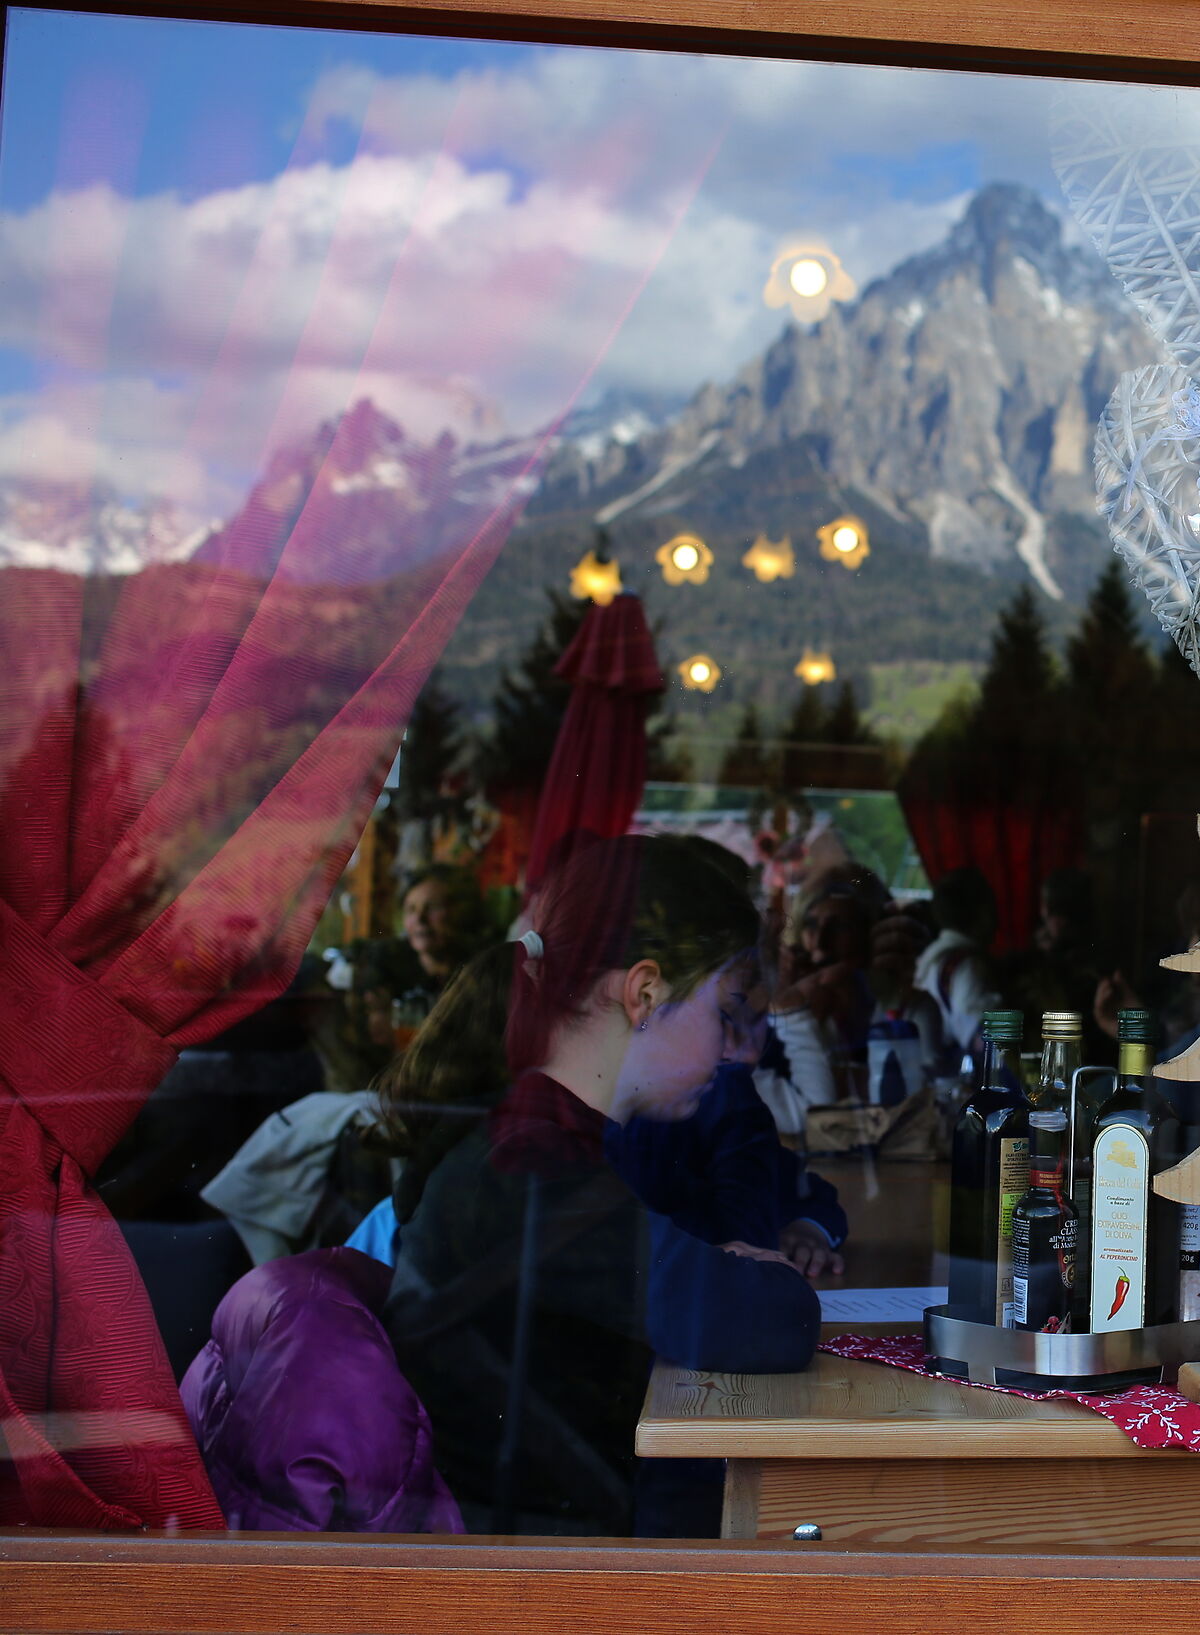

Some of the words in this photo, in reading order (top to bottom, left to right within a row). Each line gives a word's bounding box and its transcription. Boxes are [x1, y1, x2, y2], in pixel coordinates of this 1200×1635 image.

[1105, 1230, 1112, 1238] DI
[1113, 1231, 1133, 1239] OLIVA
[1107, 1254, 1139, 1262] PEPERONCINO
